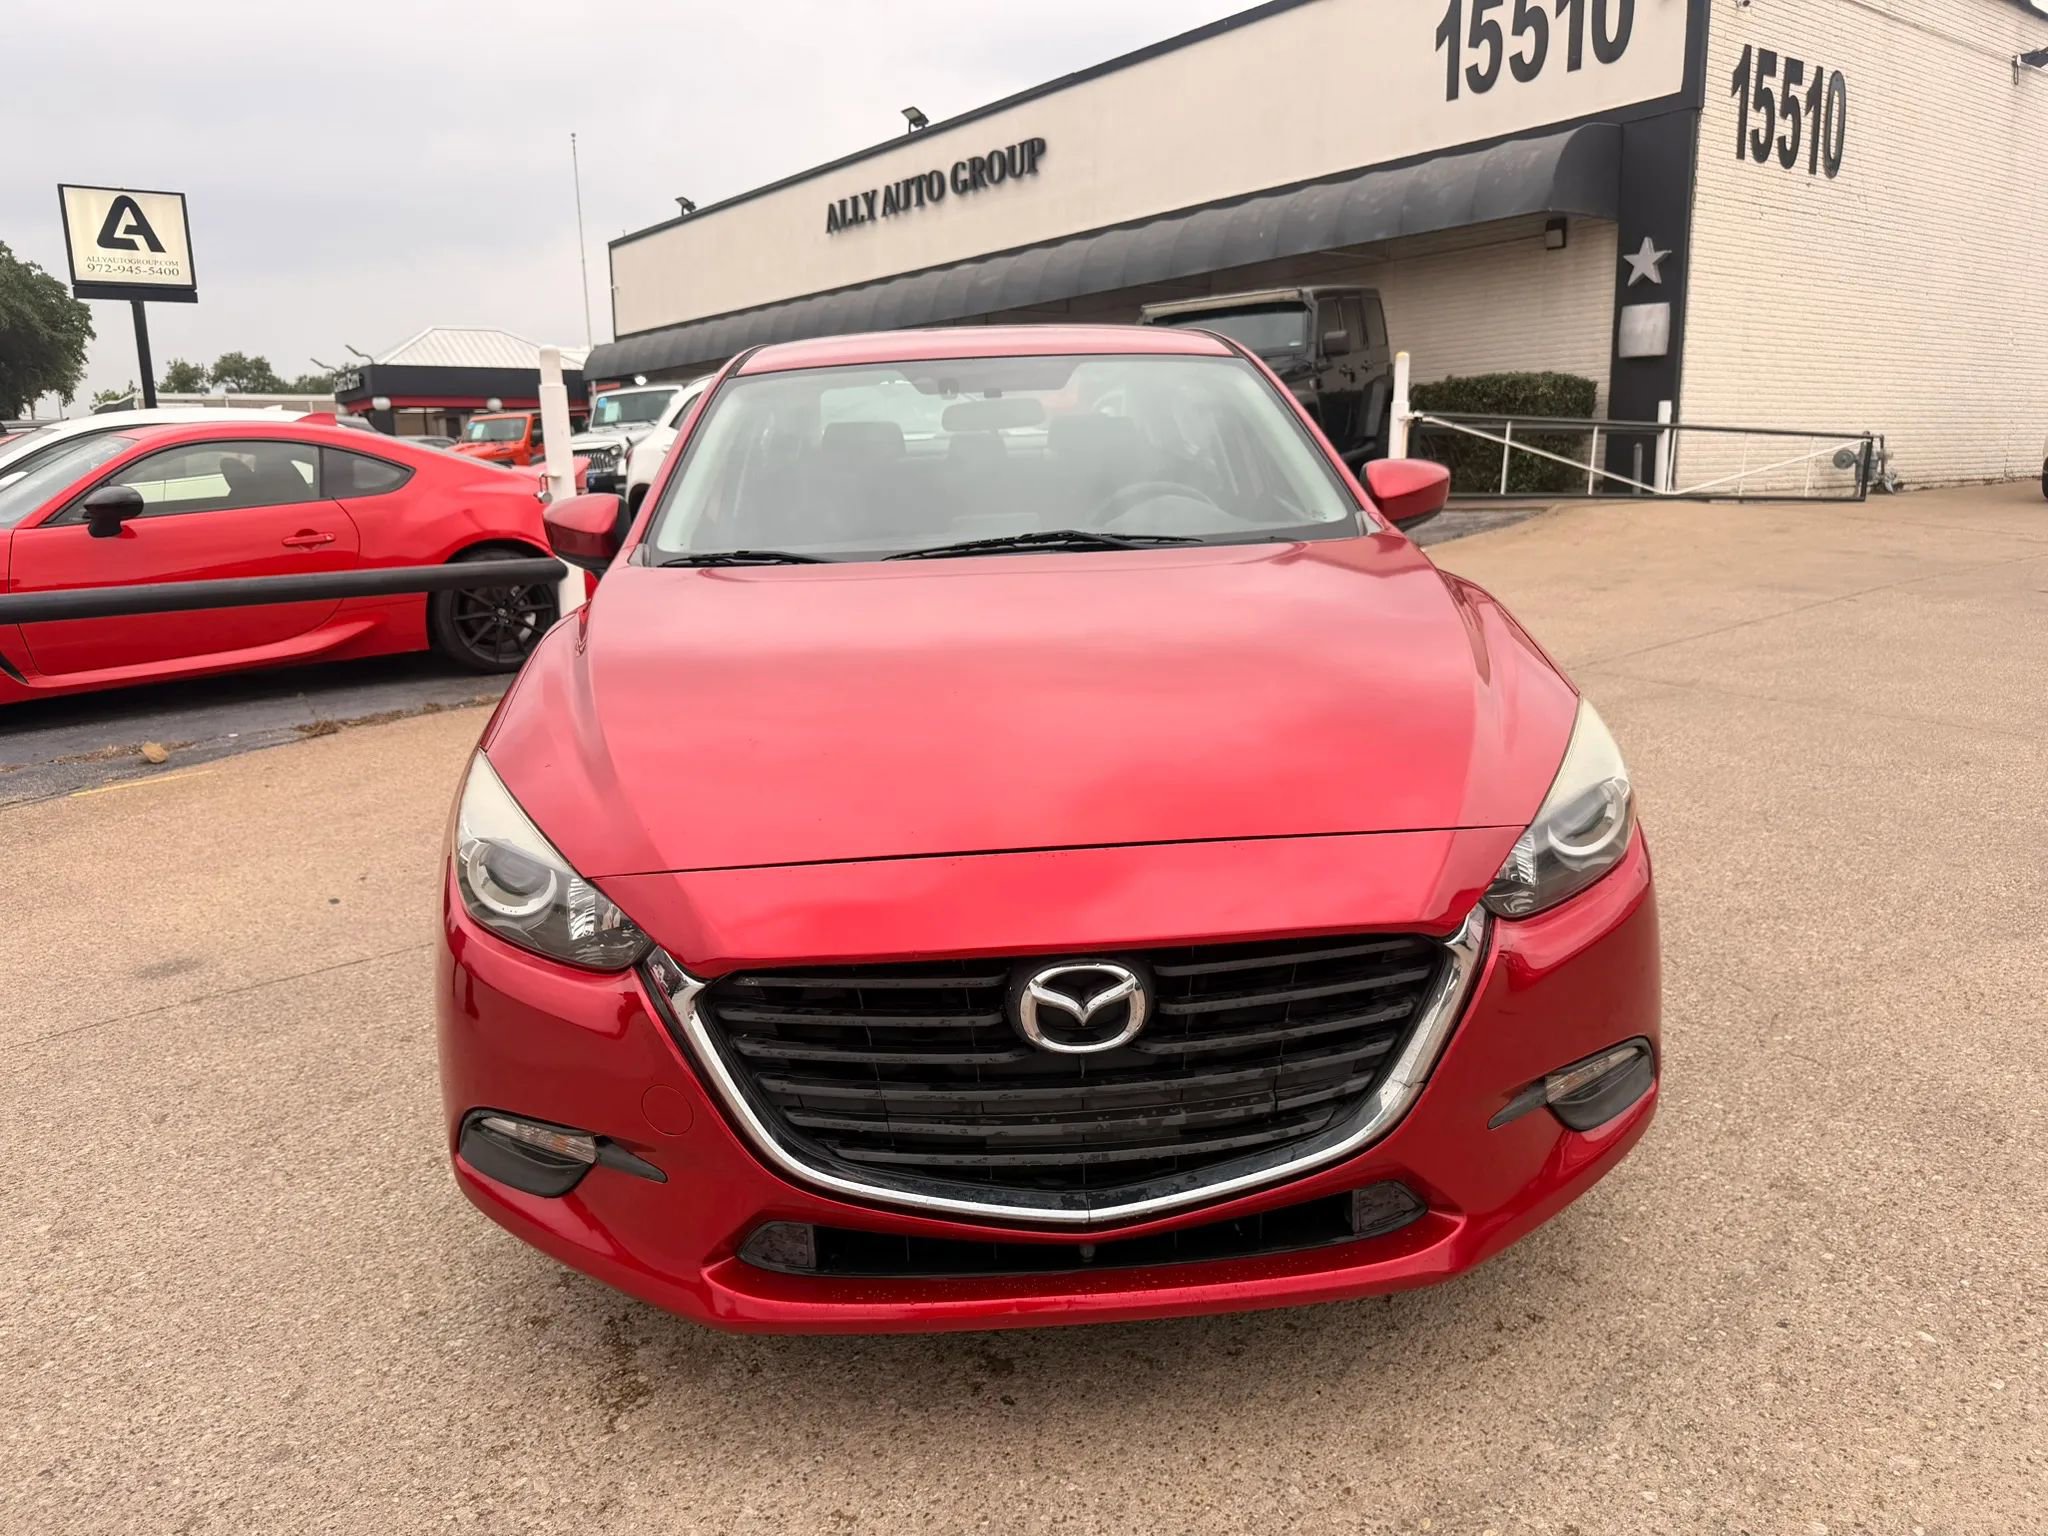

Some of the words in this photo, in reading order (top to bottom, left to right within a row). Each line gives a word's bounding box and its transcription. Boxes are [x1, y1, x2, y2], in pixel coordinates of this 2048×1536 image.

[1435, 0, 1635, 102] 15510
[1731, 44, 1846, 179] 15510
[826, 189, 878, 234] ALLY
[881, 169, 946, 217] AUTO
[950, 137, 1047, 195] GROUP
[87, 263, 180, 276] 972-945-5400
